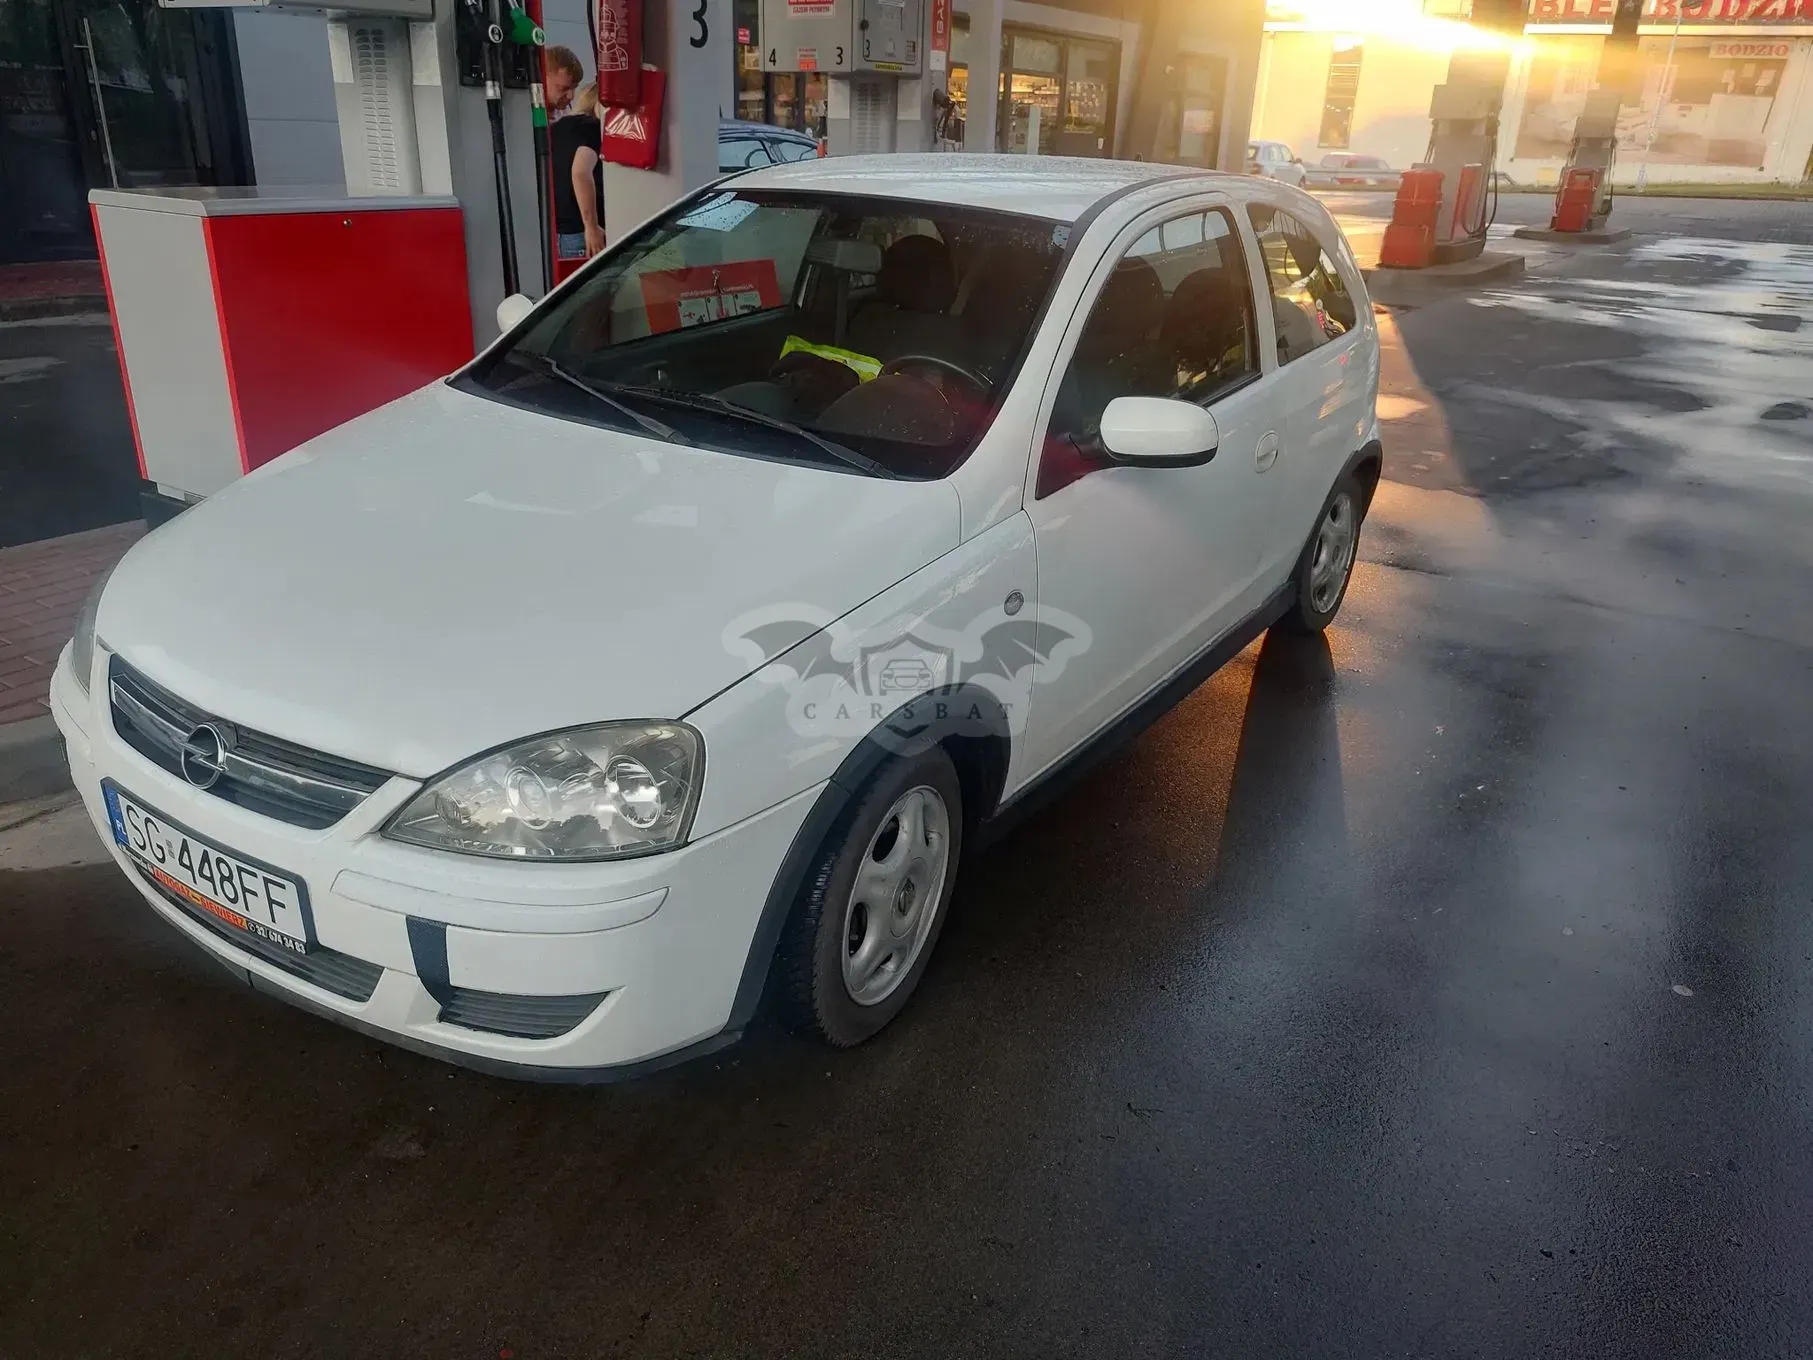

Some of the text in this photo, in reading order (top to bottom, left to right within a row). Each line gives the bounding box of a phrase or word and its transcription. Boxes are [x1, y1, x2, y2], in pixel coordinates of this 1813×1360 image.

[690, 0, 708, 48] 3
[768, 48, 777, 66] 4
[835, 47, 844, 65] 3
[1715, 43, 1789, 56] BODZIO
[115, 819, 127, 835] PL
[126, 804, 287, 924] SG 448FF
